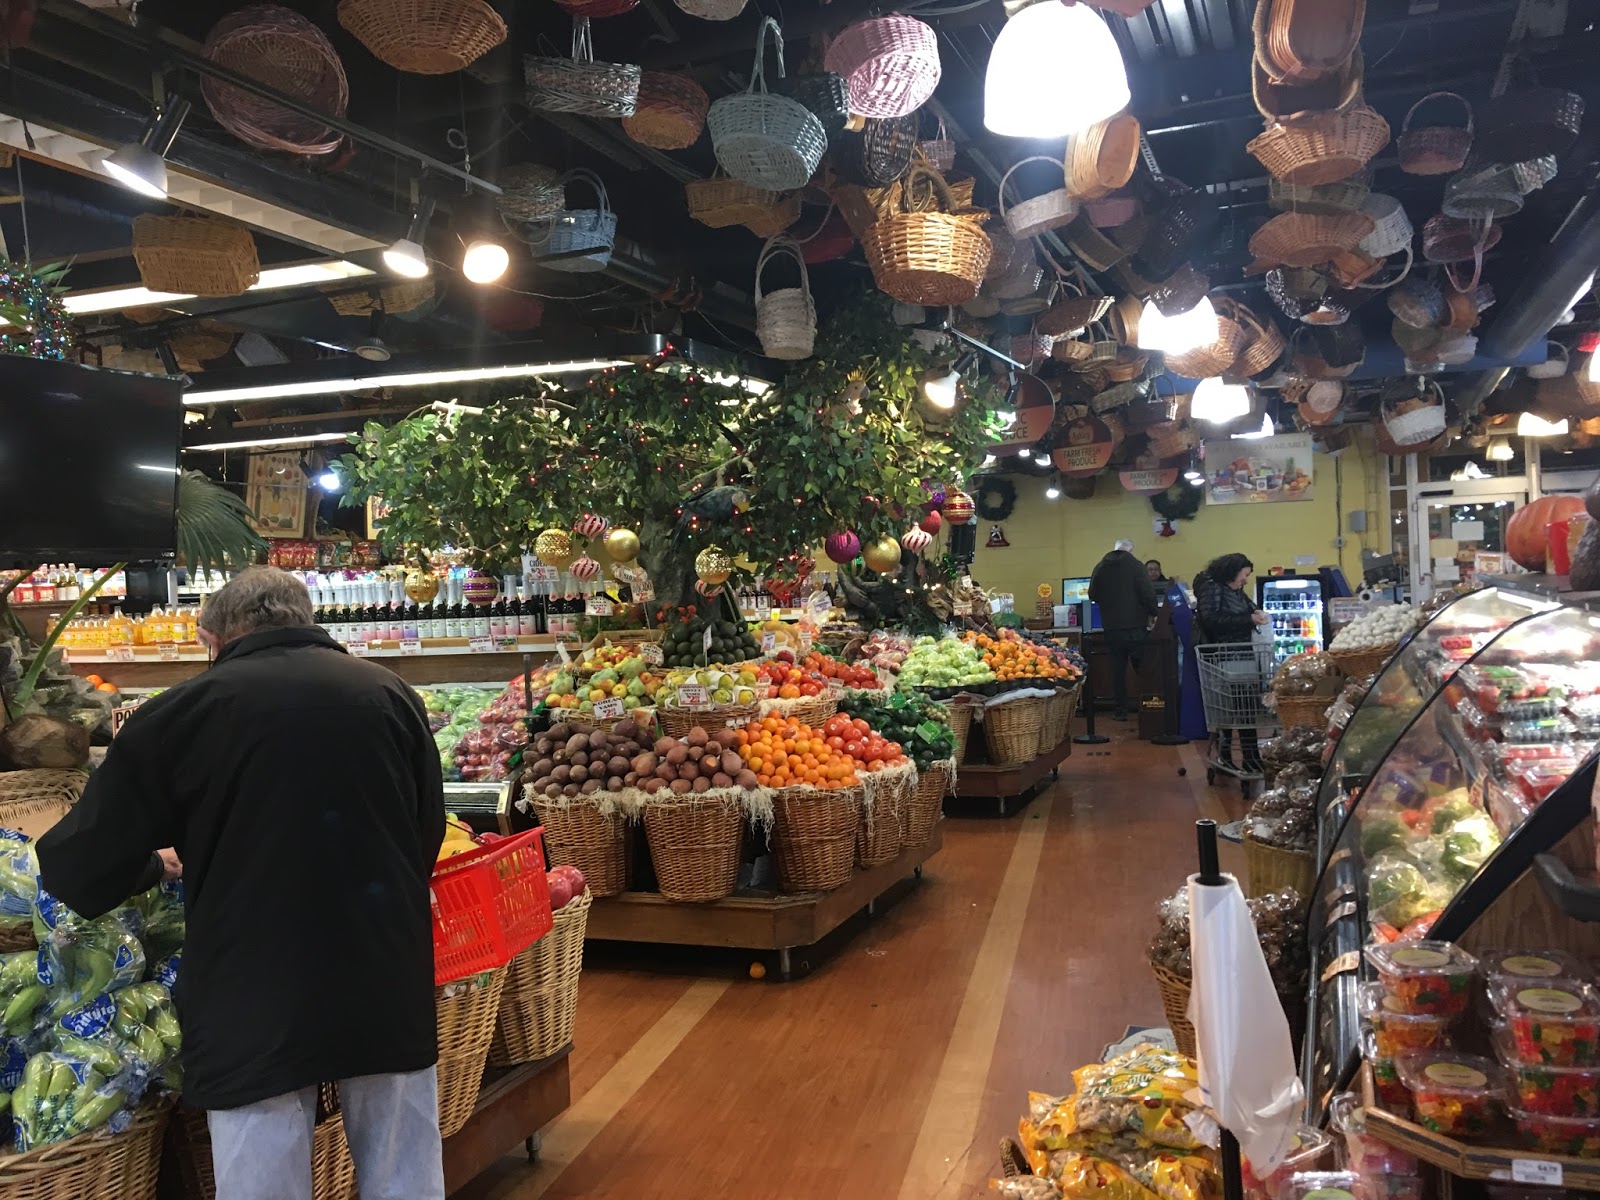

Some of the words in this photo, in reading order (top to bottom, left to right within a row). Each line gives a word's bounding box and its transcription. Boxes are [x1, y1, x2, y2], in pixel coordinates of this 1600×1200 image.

[1064, 449, 1080, 459] FARM
[1081, 446, 1100, 457] FRESH
[1068, 456, 1097, 467] PRODUCE
[1130, 471, 1146, 481] FARM
[1133, 478, 1163, 487] PRODUCE
[593, 697, 622, 706] KOREAN
